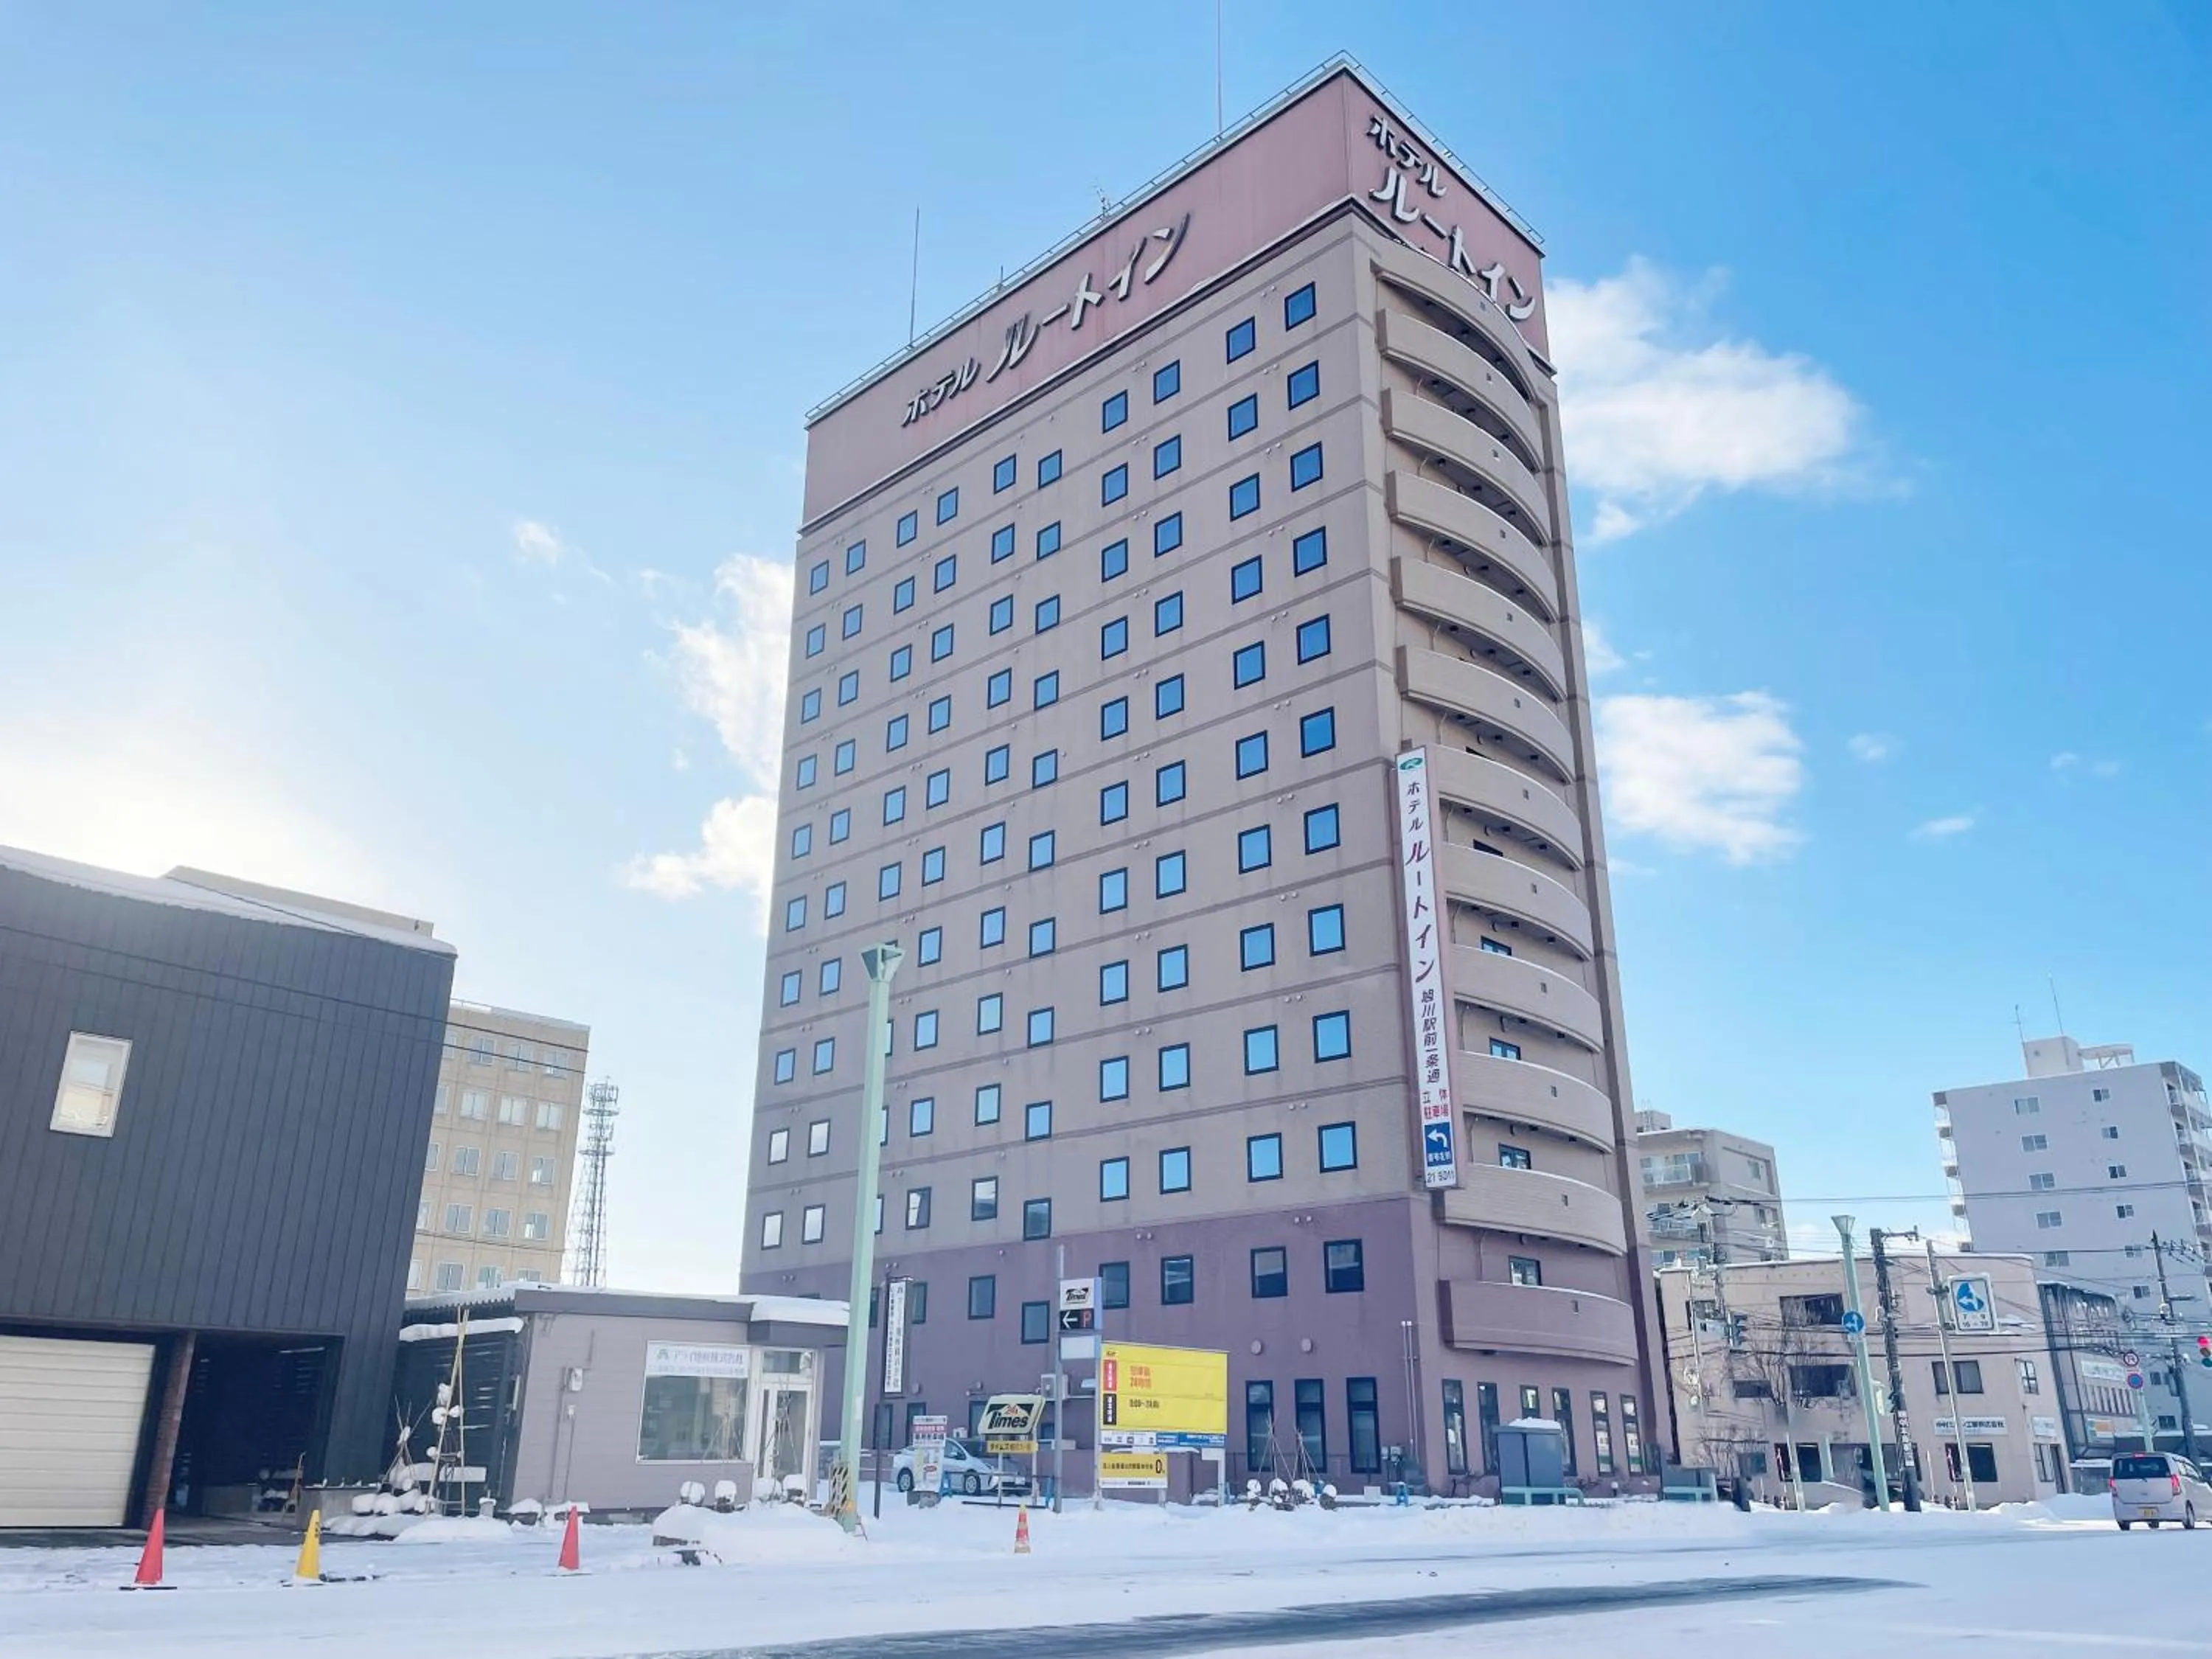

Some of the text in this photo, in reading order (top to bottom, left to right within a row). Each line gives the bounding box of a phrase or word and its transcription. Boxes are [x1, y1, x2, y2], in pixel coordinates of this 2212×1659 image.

[1367, 114, 1447, 198] ホテル
[1368, 166, 1536, 321] ルートイン
[902, 212, 1190, 427] ホテル ルートイン
[1405, 781, 1434, 984] ホテル ルートイン
[1066, 1291, 1086, 1301] Times
[1083, 1310, 1092, 1328] P
[988, 1411, 1029, 1430] Times
